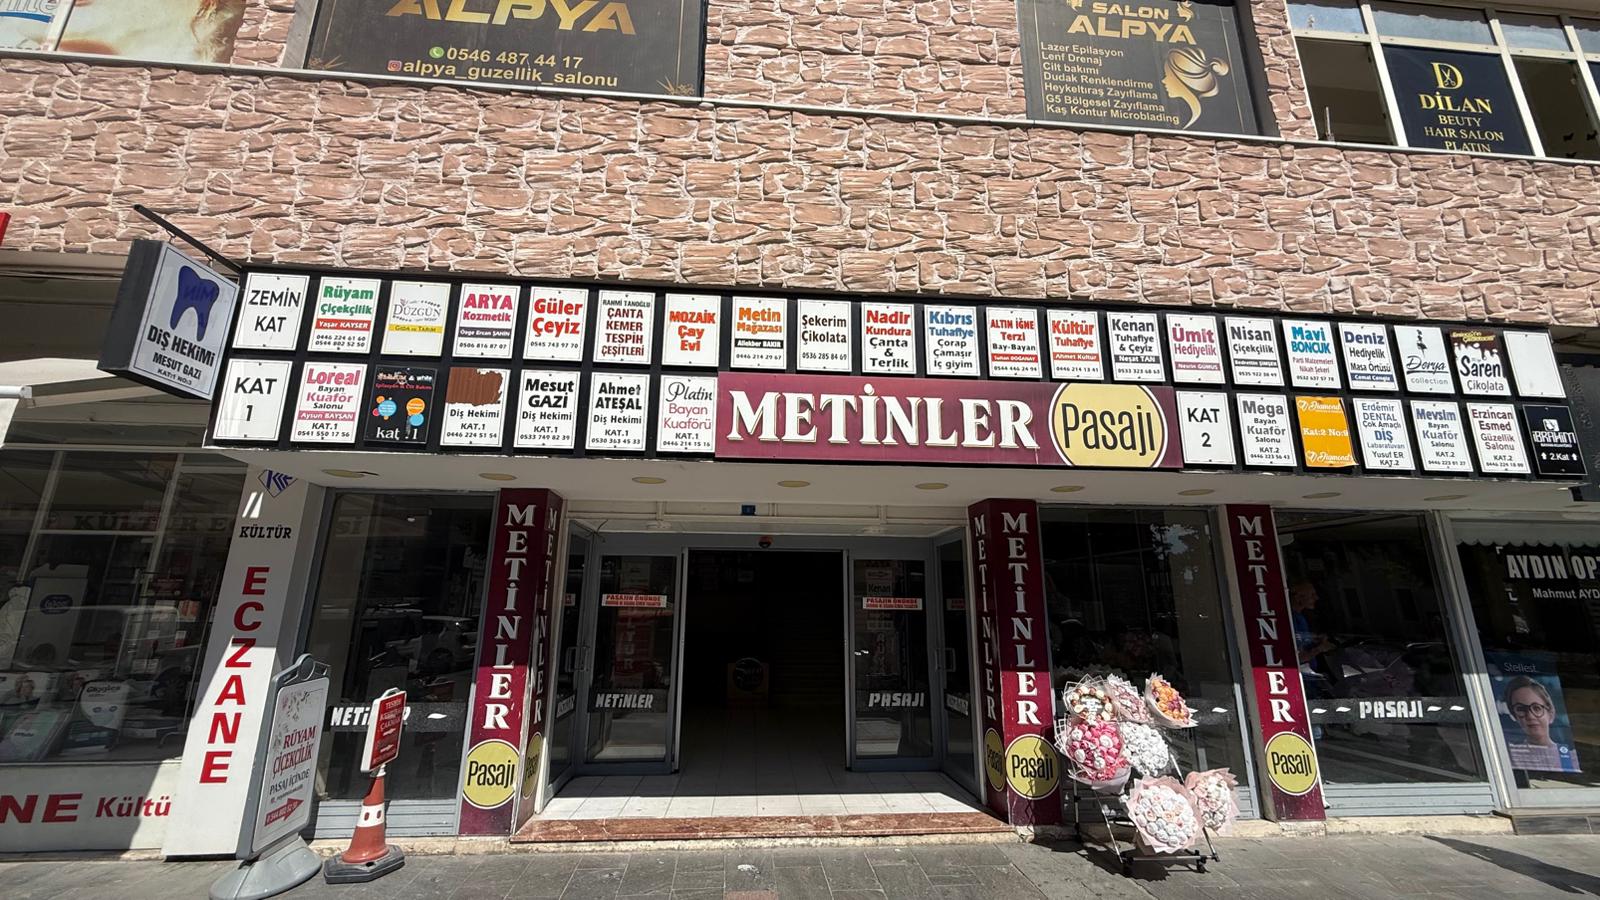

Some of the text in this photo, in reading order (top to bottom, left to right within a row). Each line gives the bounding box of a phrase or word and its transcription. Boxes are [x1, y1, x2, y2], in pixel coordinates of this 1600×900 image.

[1092, 0, 1169, 20] SALON
[1067, 14, 1196, 45] ALPYA
[1041, 42, 1124, 58] Lazer Epilasyon
[446, 47, 584, 68] 0546 487 44 17
[1042, 52, 1102, 66] Lenf Drenaj
[402, 60, 618, 87] alpya_guzellik_salonu
[1042, 62, 1099, 75] Cilt bakımı
[1044, 72, 1154, 90] Dudak Renklendirme
[1107, 86, 1158, 100] Zayıflama
[1046, 94, 1164, 112] G5 Bölgesel Zayıflama
[1419, 91, 1493, 114] DİLAN
[1046, 104, 1180, 125] Kaş Kontur Microblading
[1438, 114, 1482, 128] BEUTY
[1424, 126, 1504, 142] HAIR SALON
[250, 287, 301, 308] ZEMİN
[322, 285, 374, 301] Rüyam
[464, 293, 512, 310] ARYA
[534, 298, 583, 316] Güler
[320, 303, 373, 316] Çiçekçilik
[462, 311, 511, 322] Kozmetik
[608, 307, 644, 320] ÇANTA
[738, 307, 781, 322] Metin
[866, 309, 911, 324] Nadir
[254, 316, 286, 332] KAT
[669, 310, 716, 324] MOZAİK
[802, 314, 847, 330] Şekerim
[929, 310, 973, 325] Kıbrıs
[990, 317, 1035, 330] ALTIN İĞNE
[532, 318, 580, 337] Çeyiz
[606, 320, 643, 332] KEMER
[677, 325, 704, 339] Çay
[737, 321, 782, 334] Mağazası
[866, 326, 912, 337] Kundura
[1052, 320, 1094, 335] Kültür
[1112, 319, 1154, 332] Kenan
[605, 332, 643, 344] TESPİH
[802, 330, 847, 346] Çikolata
[929, 327, 974, 340] Tuhafiye
[1000, 331, 1025, 341] Terzi
[1114, 334, 1154, 344] Tuhafiye
[1172, 323, 1214, 343] Ümit
[1230, 326, 1272, 341] Nisan
[1291, 326, 1326, 341] Mavi
[1344, 331, 1384, 345] Deniz
[680, 340, 700, 351] Evi
[870, 337, 908, 350] Çanta
[938, 339, 967, 349] Çorap
[992, 343, 1036, 352] Bay-Bayan
[1054, 337, 1093, 350] Tuhafiye
[1119, 344, 1153, 354] & Çeyiz
[1233, 344, 1274, 355] Çiçekçilik
[1291, 341, 1331, 354] BONCUK
[601, 345, 644, 358] ÇEŞİTLERİ
[884, 349, 894, 357] &
[933, 349, 972, 358] Çamaşır
[1174, 344, 1217, 358] Hediyelik
[1349, 347, 1385, 360] Hediyelik
[152, 352, 182, 373] MESUT
[870, 358, 909, 368] Terlik
[946, 360, 973, 370] giyim
[1369, 361, 1391, 372] Örtüsü
[1460, 355, 1500, 377] Saren
[306, 368, 361, 385] Loreal
[1410, 377, 1449, 385] collection
[234, 377, 277, 395] KAT
[525, 378, 574, 392] Mesut
[598, 382, 641, 396] Ahmet
[666, 381, 713, 402] Platin
[1467, 380, 1504, 392] Çikolata
[306, 392, 353, 402] Kuaför
[528, 392, 568, 408] GAZİ
[595, 397, 642, 412] ATEŞAL
[669, 403, 708, 416] Bayan
[1243, 401, 1284, 418] Mega
[1361, 403, 1394, 412] Erdemir
[244, 404, 253, 422] 1
[450, 409, 500, 419] Diş Hekimi
[522, 411, 572, 422] Diş Hekimi
[593, 415, 642, 425] Diş Hekimi
[726, 384, 1040, 449] METİNLER
[1187, 408, 1220, 423] KAT
[1362, 412, 1397, 421] DENTAL
[1415, 408, 1456, 421] Mevsim
[1472, 408, 1513, 420] Erzincan
[534, 425, 558, 433] KAT.1
[664, 417, 711, 430] Kuaförü
[1061, 403, 1156, 456] Pasajı
[1247, 425, 1286, 436] Kuaför
[1479, 421, 1512, 431] Esmed
[376, 427, 400, 440] kat
[605, 429, 629, 437] KAT.1
[675, 432, 699, 440] KAT.1
[1201, 432, 1212, 448] 2
[1375, 428, 1393, 443] DİŞ
[1422, 430, 1458, 440] Kuaför
[1481, 433, 1515, 442] Güzellik
[1485, 442, 1515, 450] Salonu
[1550, 453, 1570, 461] 2.Kat
[240, 524, 292, 539] KÜLTÜR
[1506, 554, 1568, 580] AYDIN
[1533, 588, 1576, 600] Mahmut
[482, 504, 537, 730] METİNLER
[1001, 512, 1041, 726] METİNLER
[1237, 516, 1294, 724] METİNLER
[1504, 662, 1537, 673] Stellest
[199, 566, 270, 784] ECZANE
[868, 693, 925, 708] PASAJI
[1359, 700, 1423, 719] PASAJI
[284, 725, 316, 749] RÜYAM
[1011, 754, 1054, 781] Pasajı
[1271, 751, 1313, 778] Pasajı
[467, 759, 515, 789] Pasajı
[269, 782, 288, 795] PASAJ
